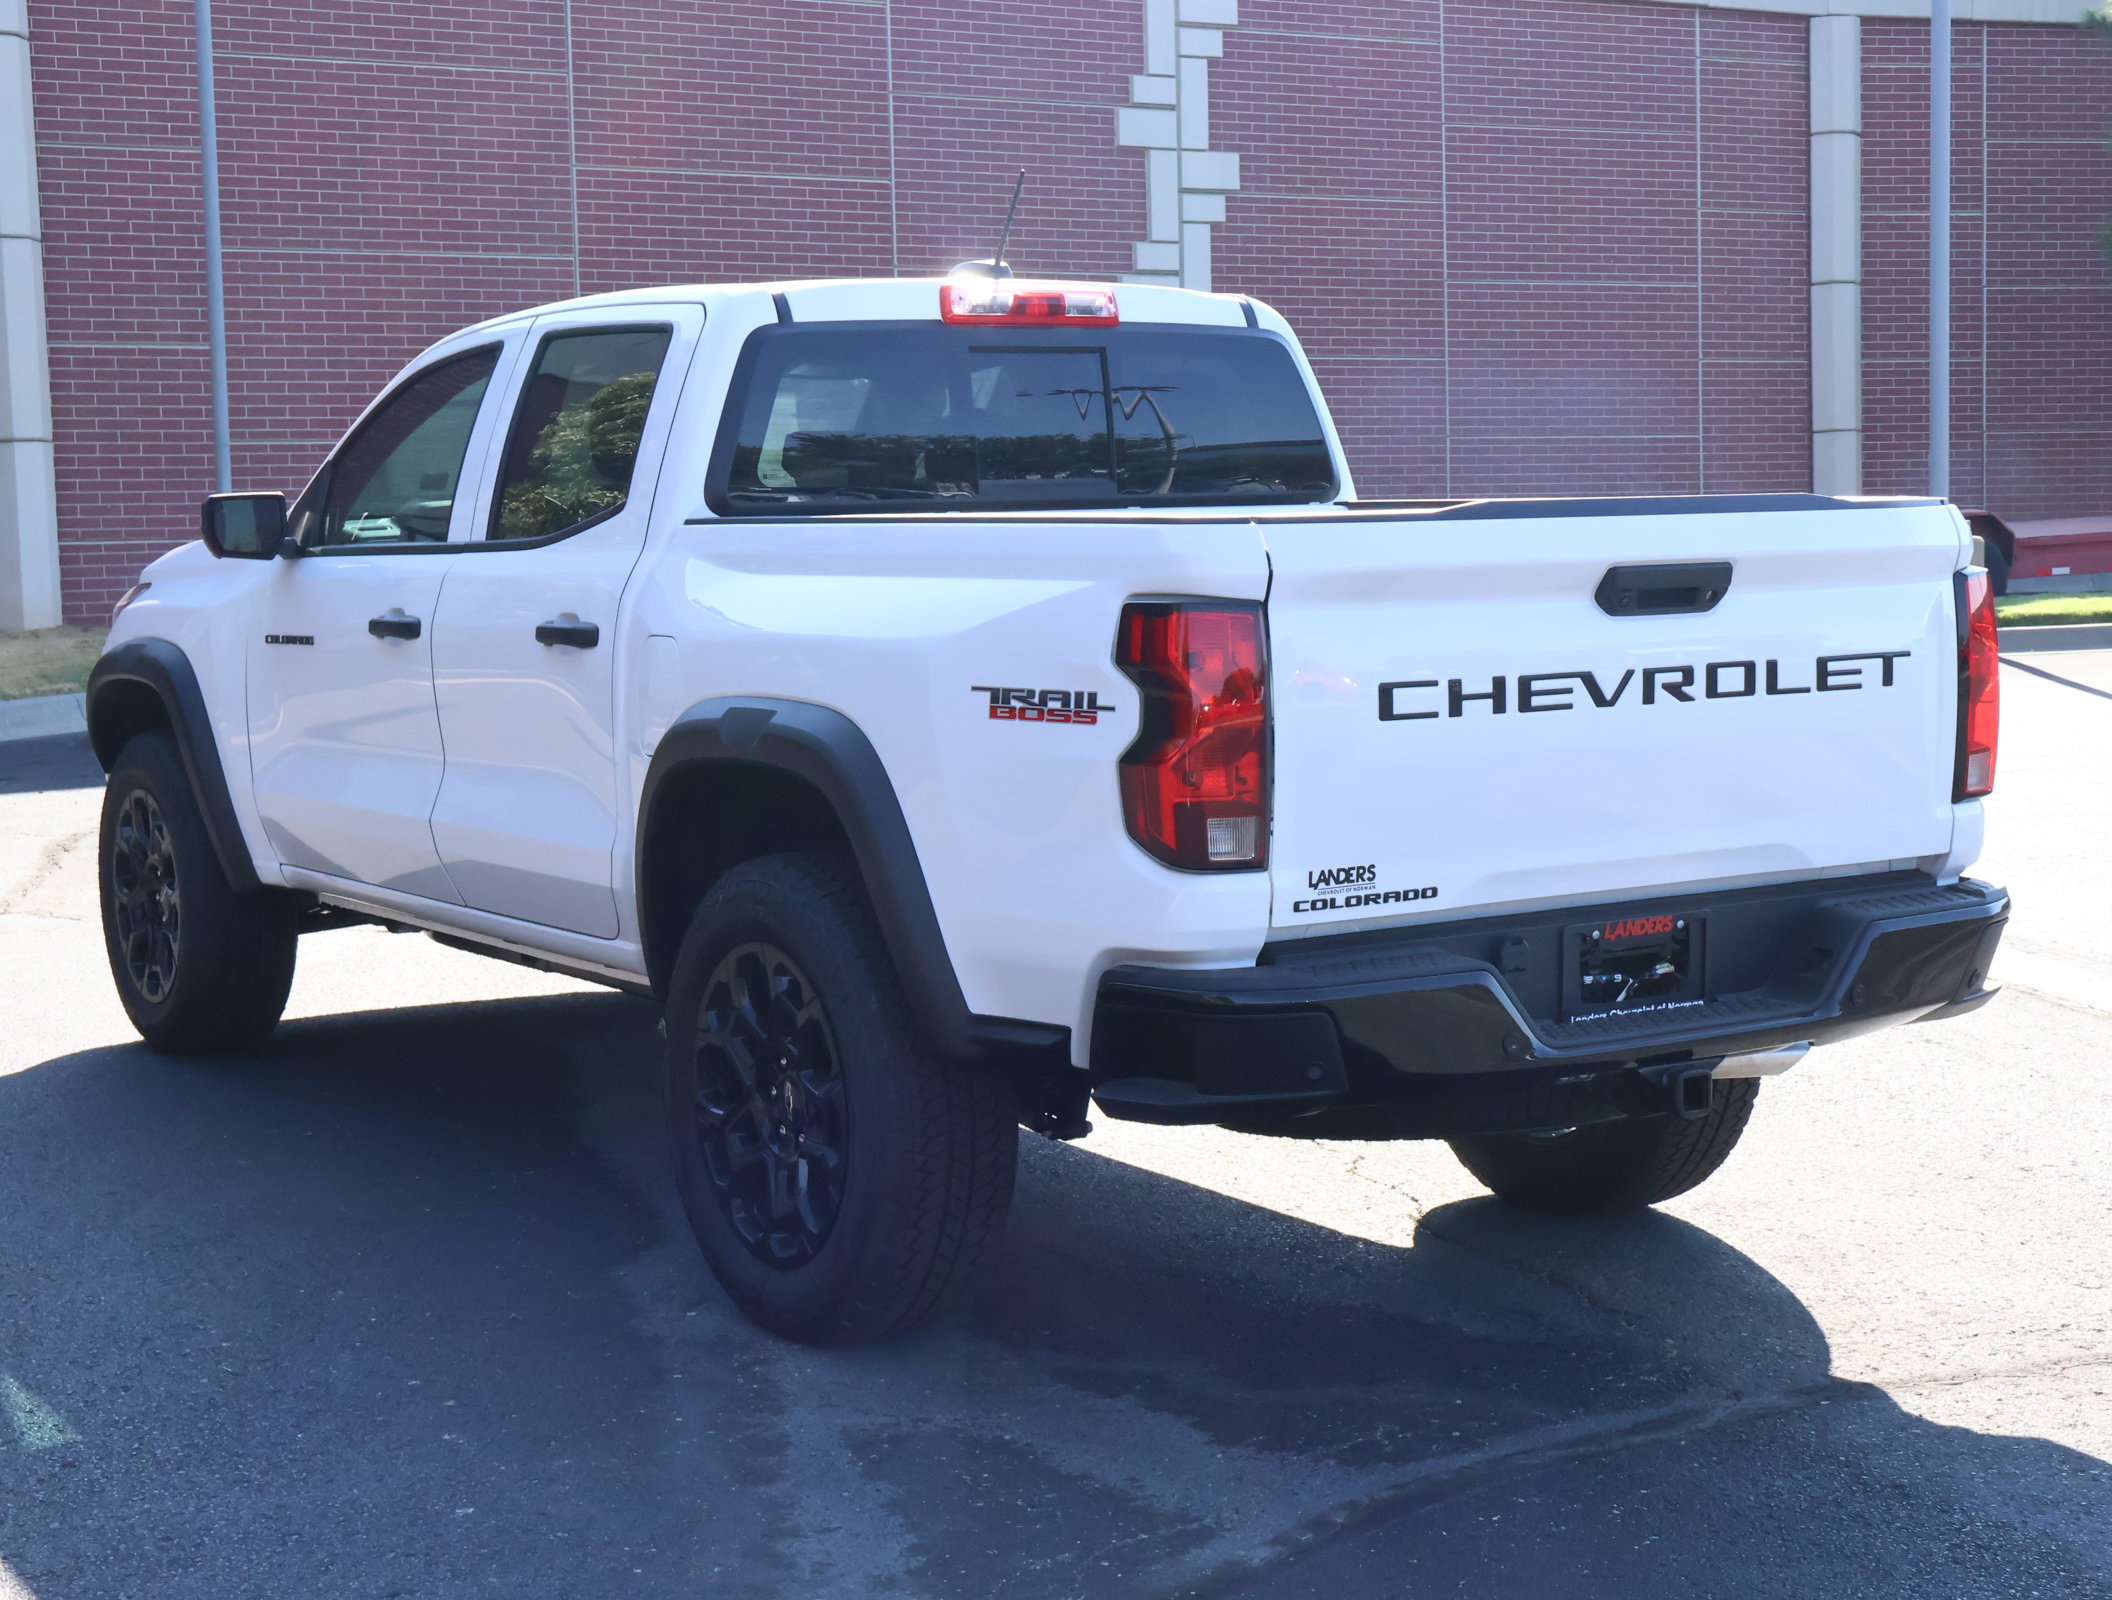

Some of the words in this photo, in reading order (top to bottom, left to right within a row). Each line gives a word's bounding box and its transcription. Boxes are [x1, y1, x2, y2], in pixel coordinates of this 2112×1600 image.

[970, 685, 1116, 712] TRAIL
[1378, 650, 1912, 722] CHEVROLET
[988, 704, 1098, 725] BOSS
[1308, 863, 1376, 890] LANDERS
[1292, 886, 1439, 913] COLORADO
[1317, 888, 1345, 897] CHEVROLET
[1353, 884, 1377, 892] NORMAN
[1604, 914, 1676, 941] LANDERS
